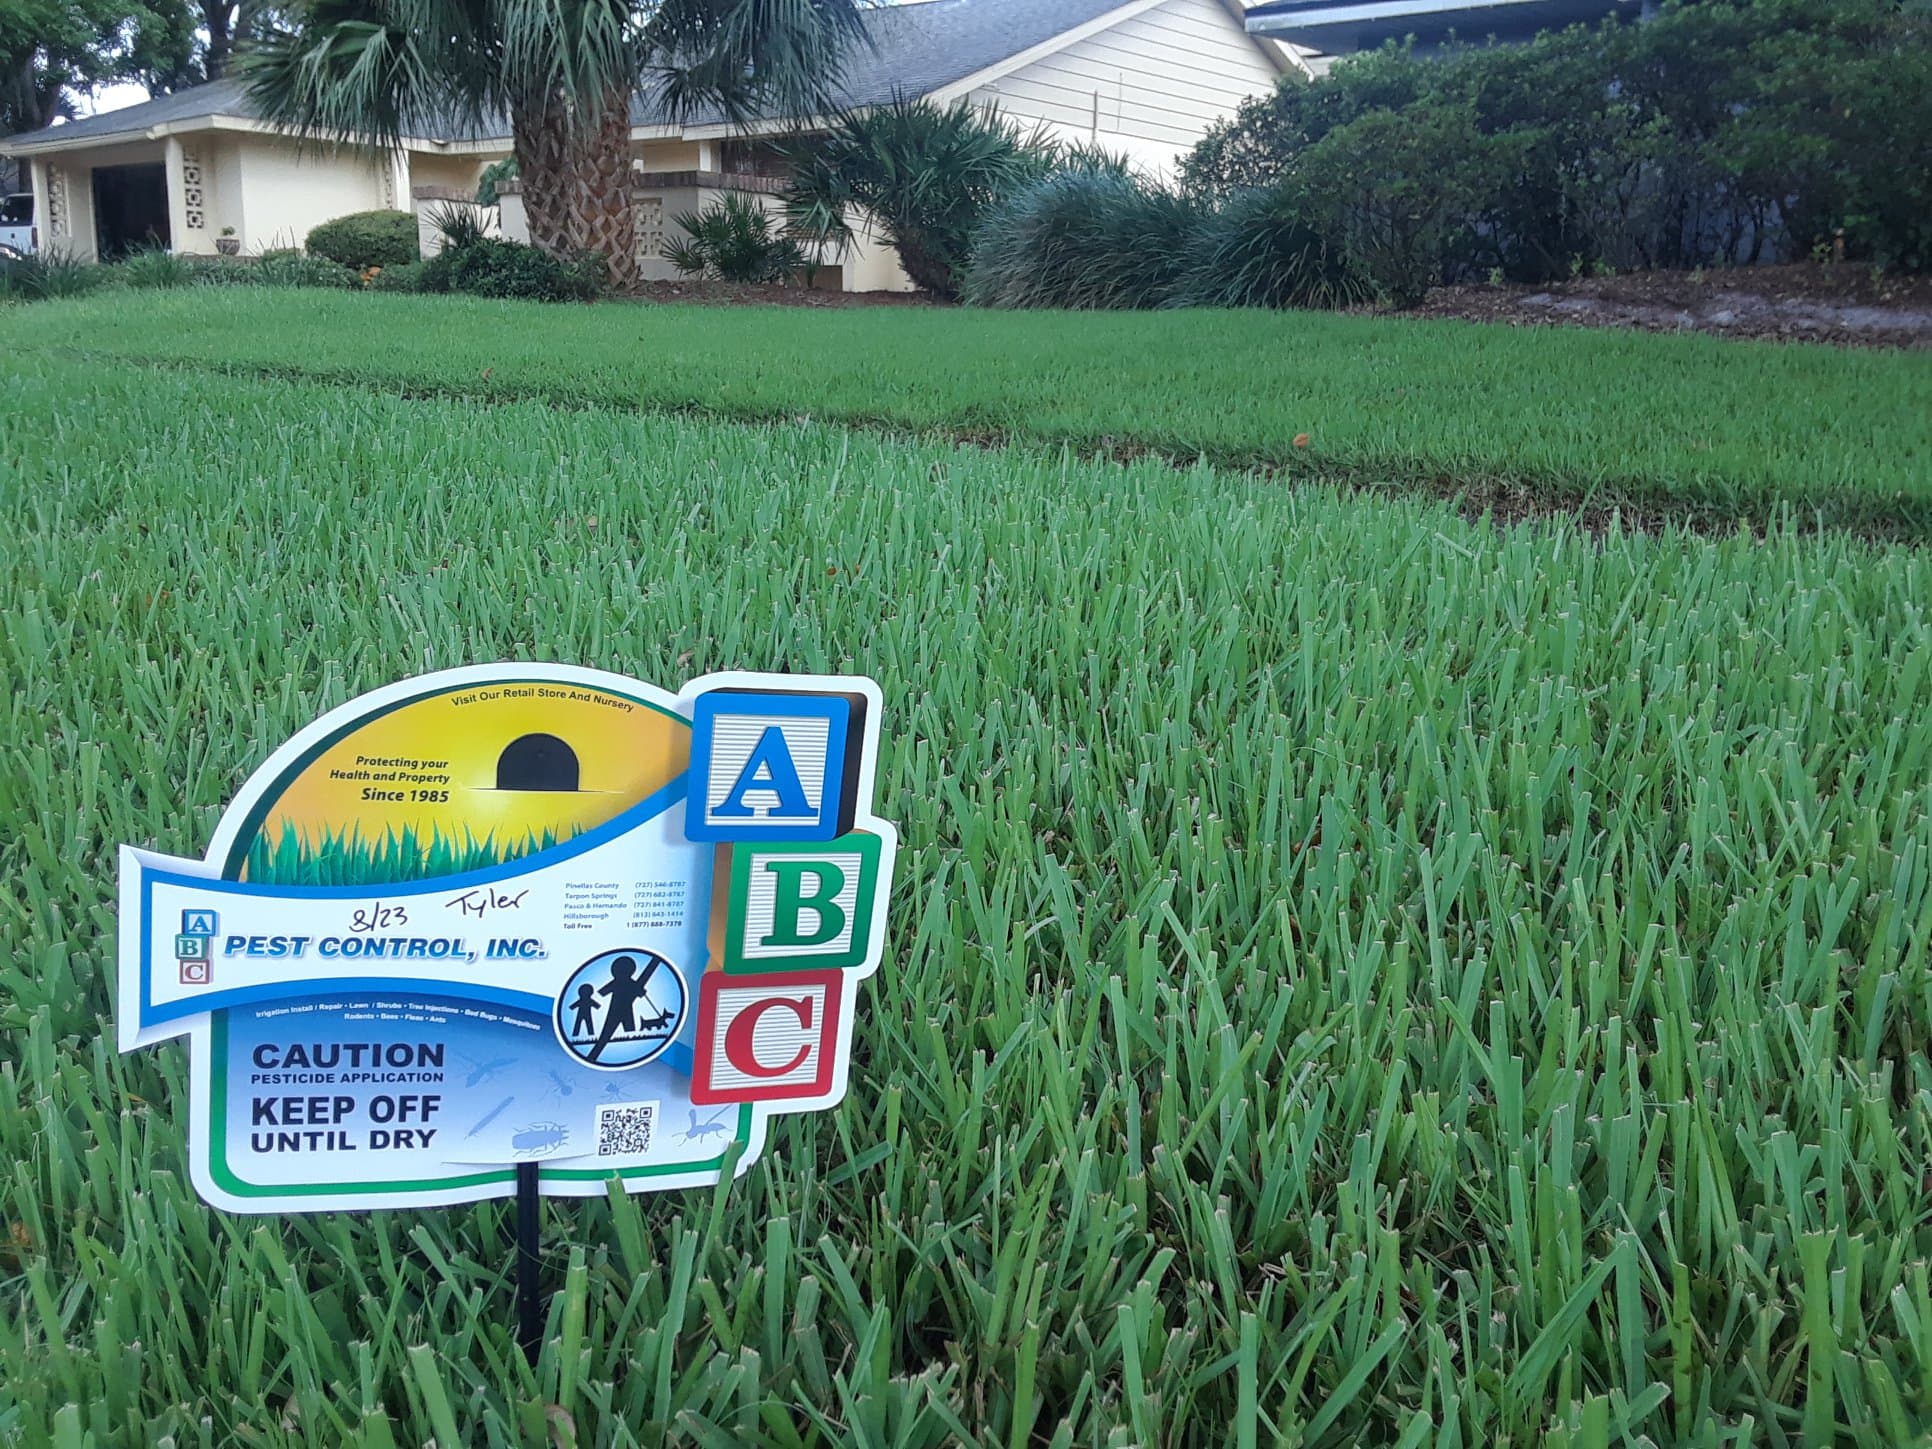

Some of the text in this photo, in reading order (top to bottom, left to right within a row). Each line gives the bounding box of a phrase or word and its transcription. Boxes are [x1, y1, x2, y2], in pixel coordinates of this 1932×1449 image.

[451, 688, 635, 713] Visit Our Retail Store And Nursery
[355, 755, 449, 769] Protecting your
[329, 769, 451, 785] Health and Property
[712, 726, 819, 817] A
[361, 787, 450, 803] Since 1985
[594, 882, 620, 890] County
[445, 888, 529, 919] Tyler
[591, 892, 618, 900] Springs
[760, 860, 846, 946] B
[189, 915, 211, 932] A
[349, 902, 409, 933] 8/23
[563, 912, 609, 921] Hillsborough
[563, 922, 576, 930] Toll
[179, 939, 199, 956] B
[223, 936, 547, 963] PEST CONTROL, INC.
[184, 964, 203, 981] C
[255, 1008, 290, 1018] Irrigation
[291, 1005, 313, 1013] Install
[318, 1003, 344, 1011] Repair
[424, 1004, 460, 1014] Injections
[428, 1015, 447, 1024] Ants
[724, 995, 814, 1078] C
[252, 1043, 445, 1069] CAUTION
[251, 1072, 444, 1085] PESTICIDE APPLICATION
[252, 1095, 441, 1126] KEEP OFF
[251, 1128, 438, 1154] UNTIL DRY
